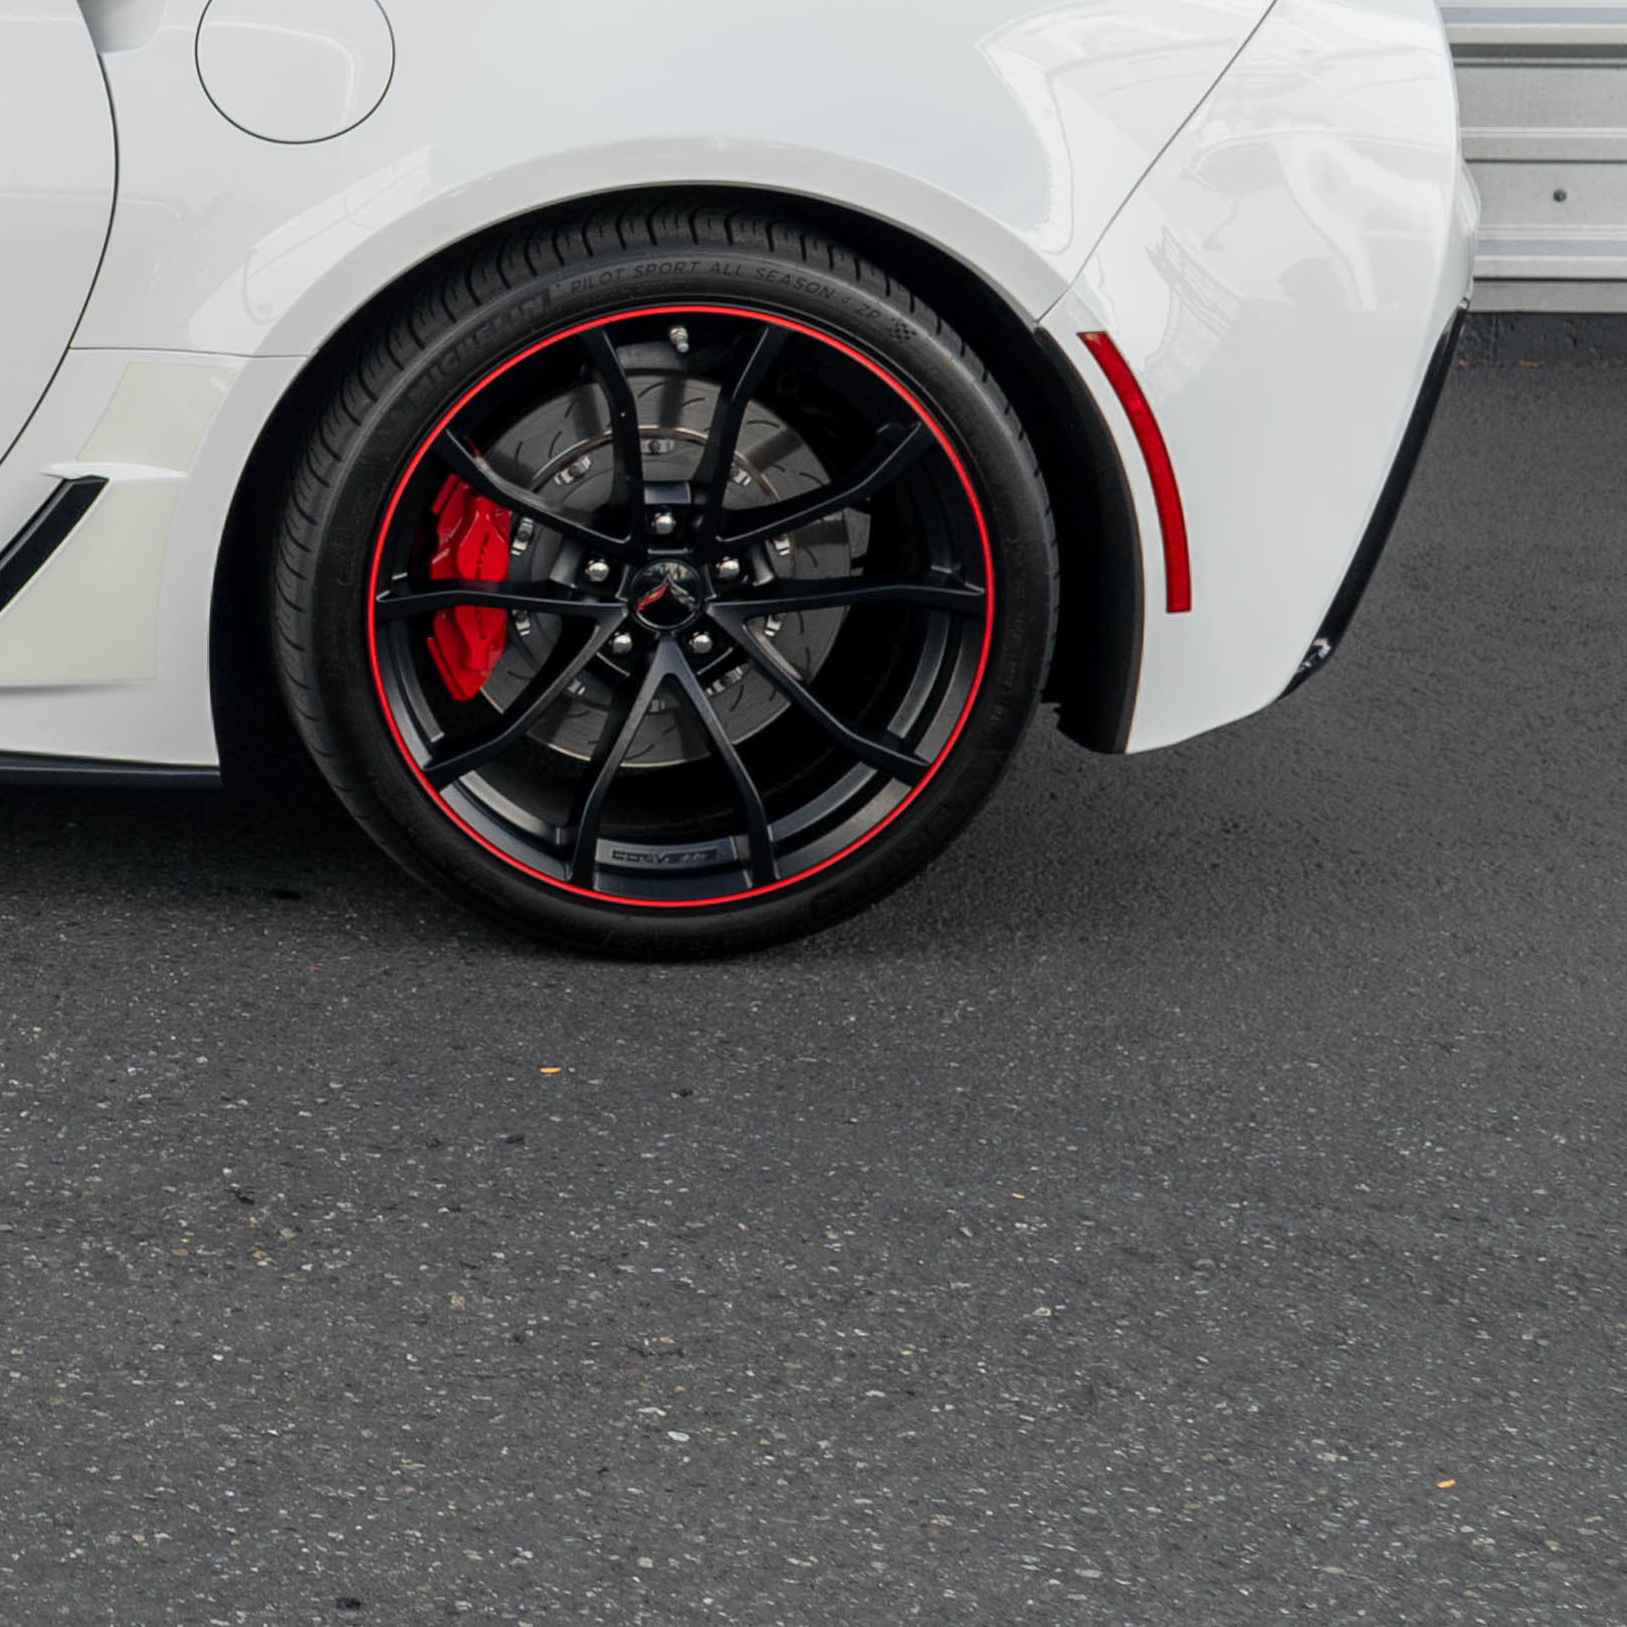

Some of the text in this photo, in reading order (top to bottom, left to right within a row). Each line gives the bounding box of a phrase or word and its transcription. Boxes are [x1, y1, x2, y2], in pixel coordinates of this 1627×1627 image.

[570, 268, 623, 294] PILOT
[633, 260, 700, 278] SPORT
[708, 260, 743, 276] ALL
[754, 267, 835, 299] SEASON
[854, 303, 882, 322] ZP
[408, 294, 545, 406] MICHELIN
